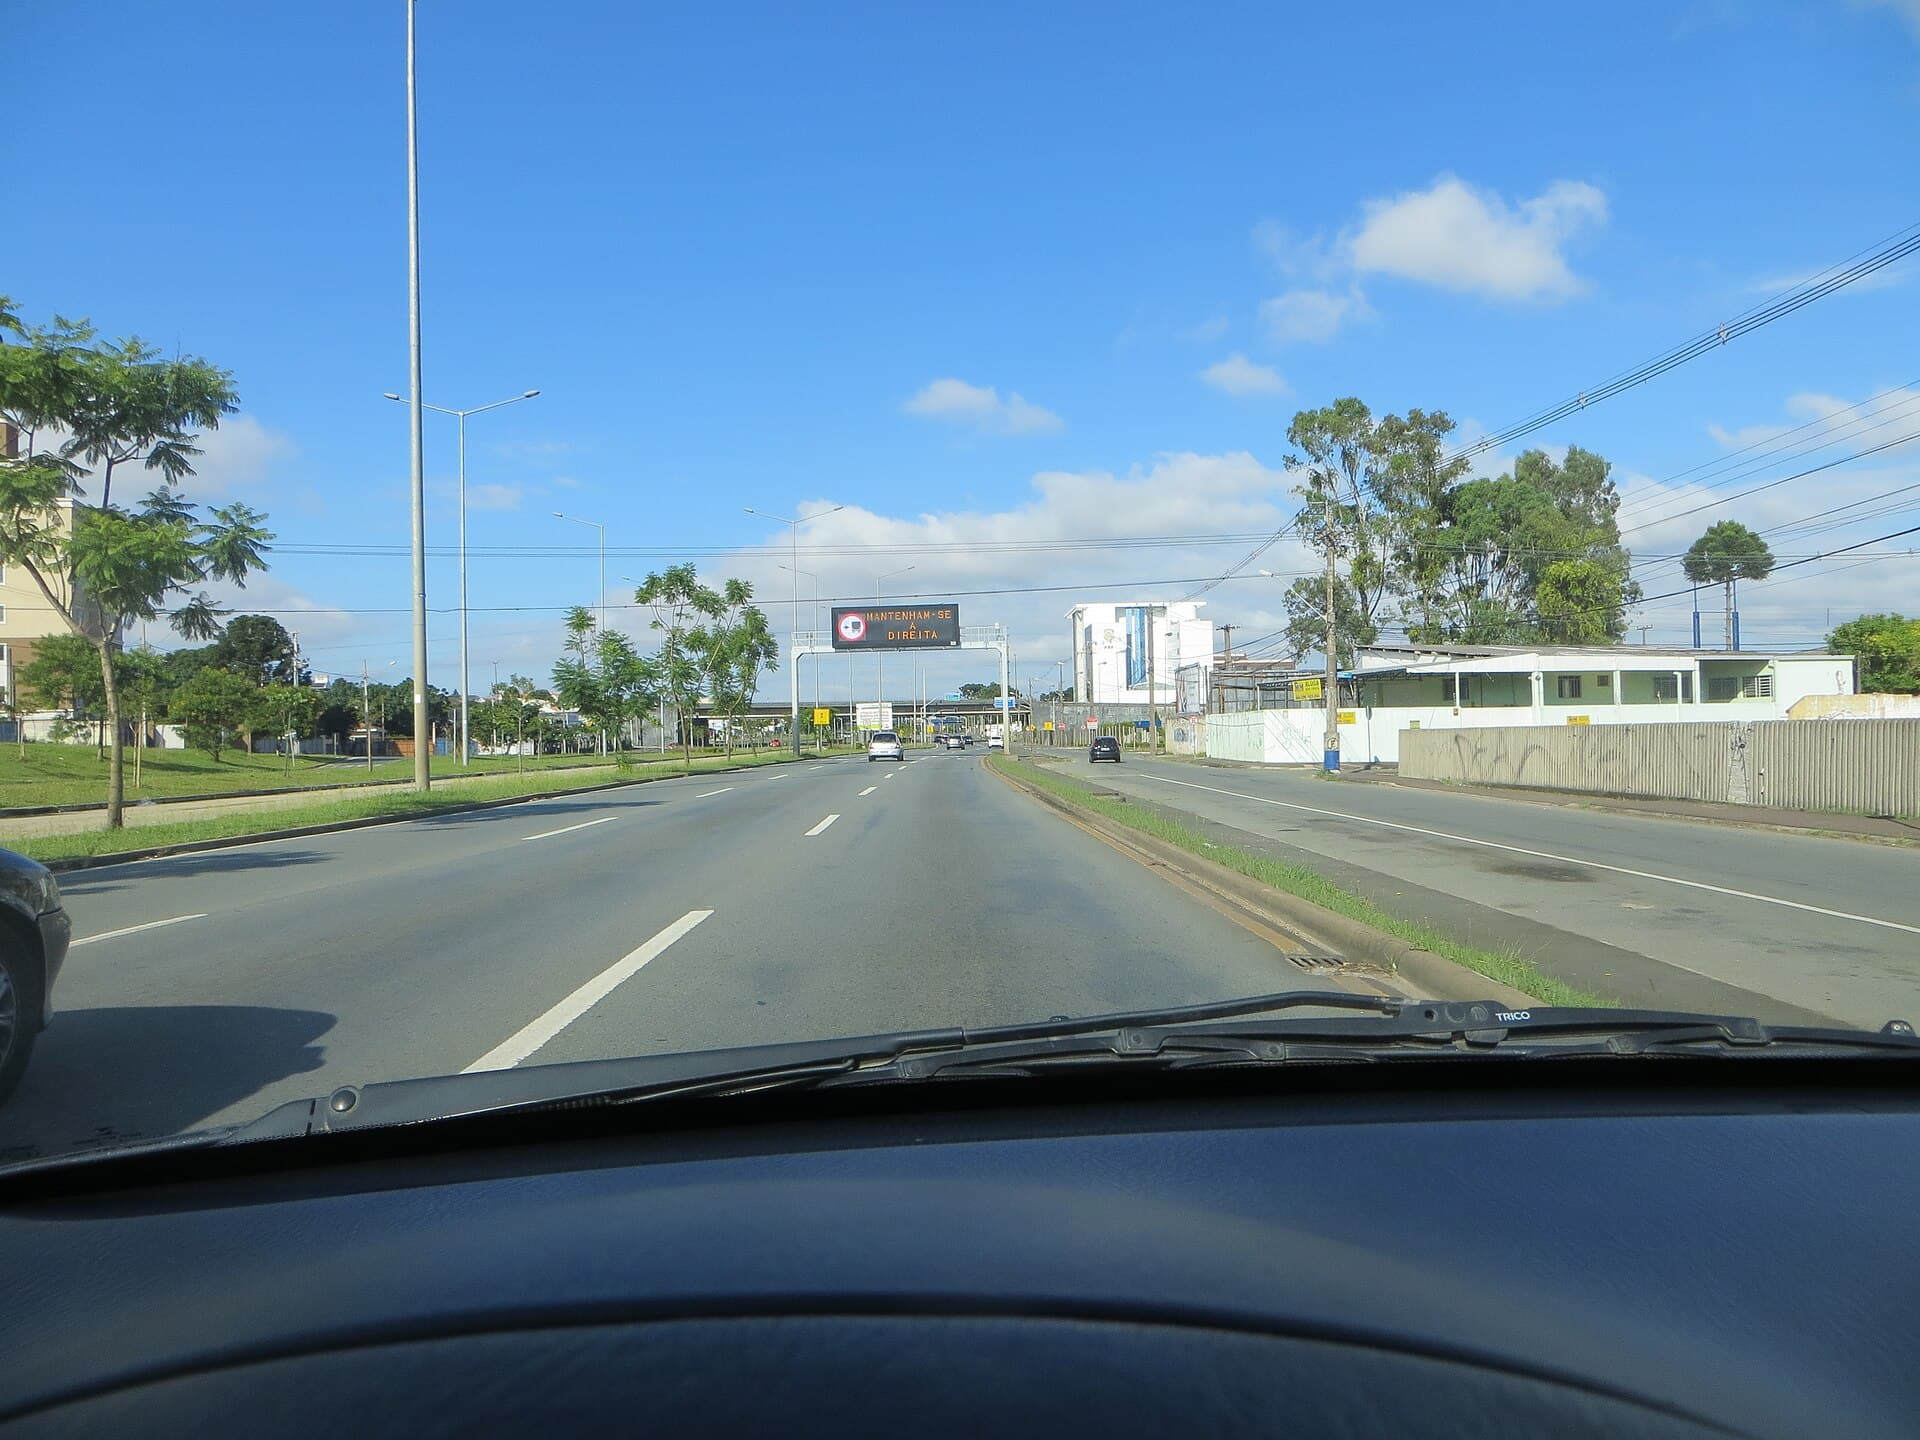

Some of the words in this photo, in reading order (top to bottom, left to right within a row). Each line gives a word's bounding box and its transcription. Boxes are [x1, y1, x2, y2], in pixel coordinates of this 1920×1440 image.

[866, 610, 951, 621] MANTENHAM-SE
[888, 630, 938, 640] DIREITA
[1495, 1011, 1530, 1022] TRICO
